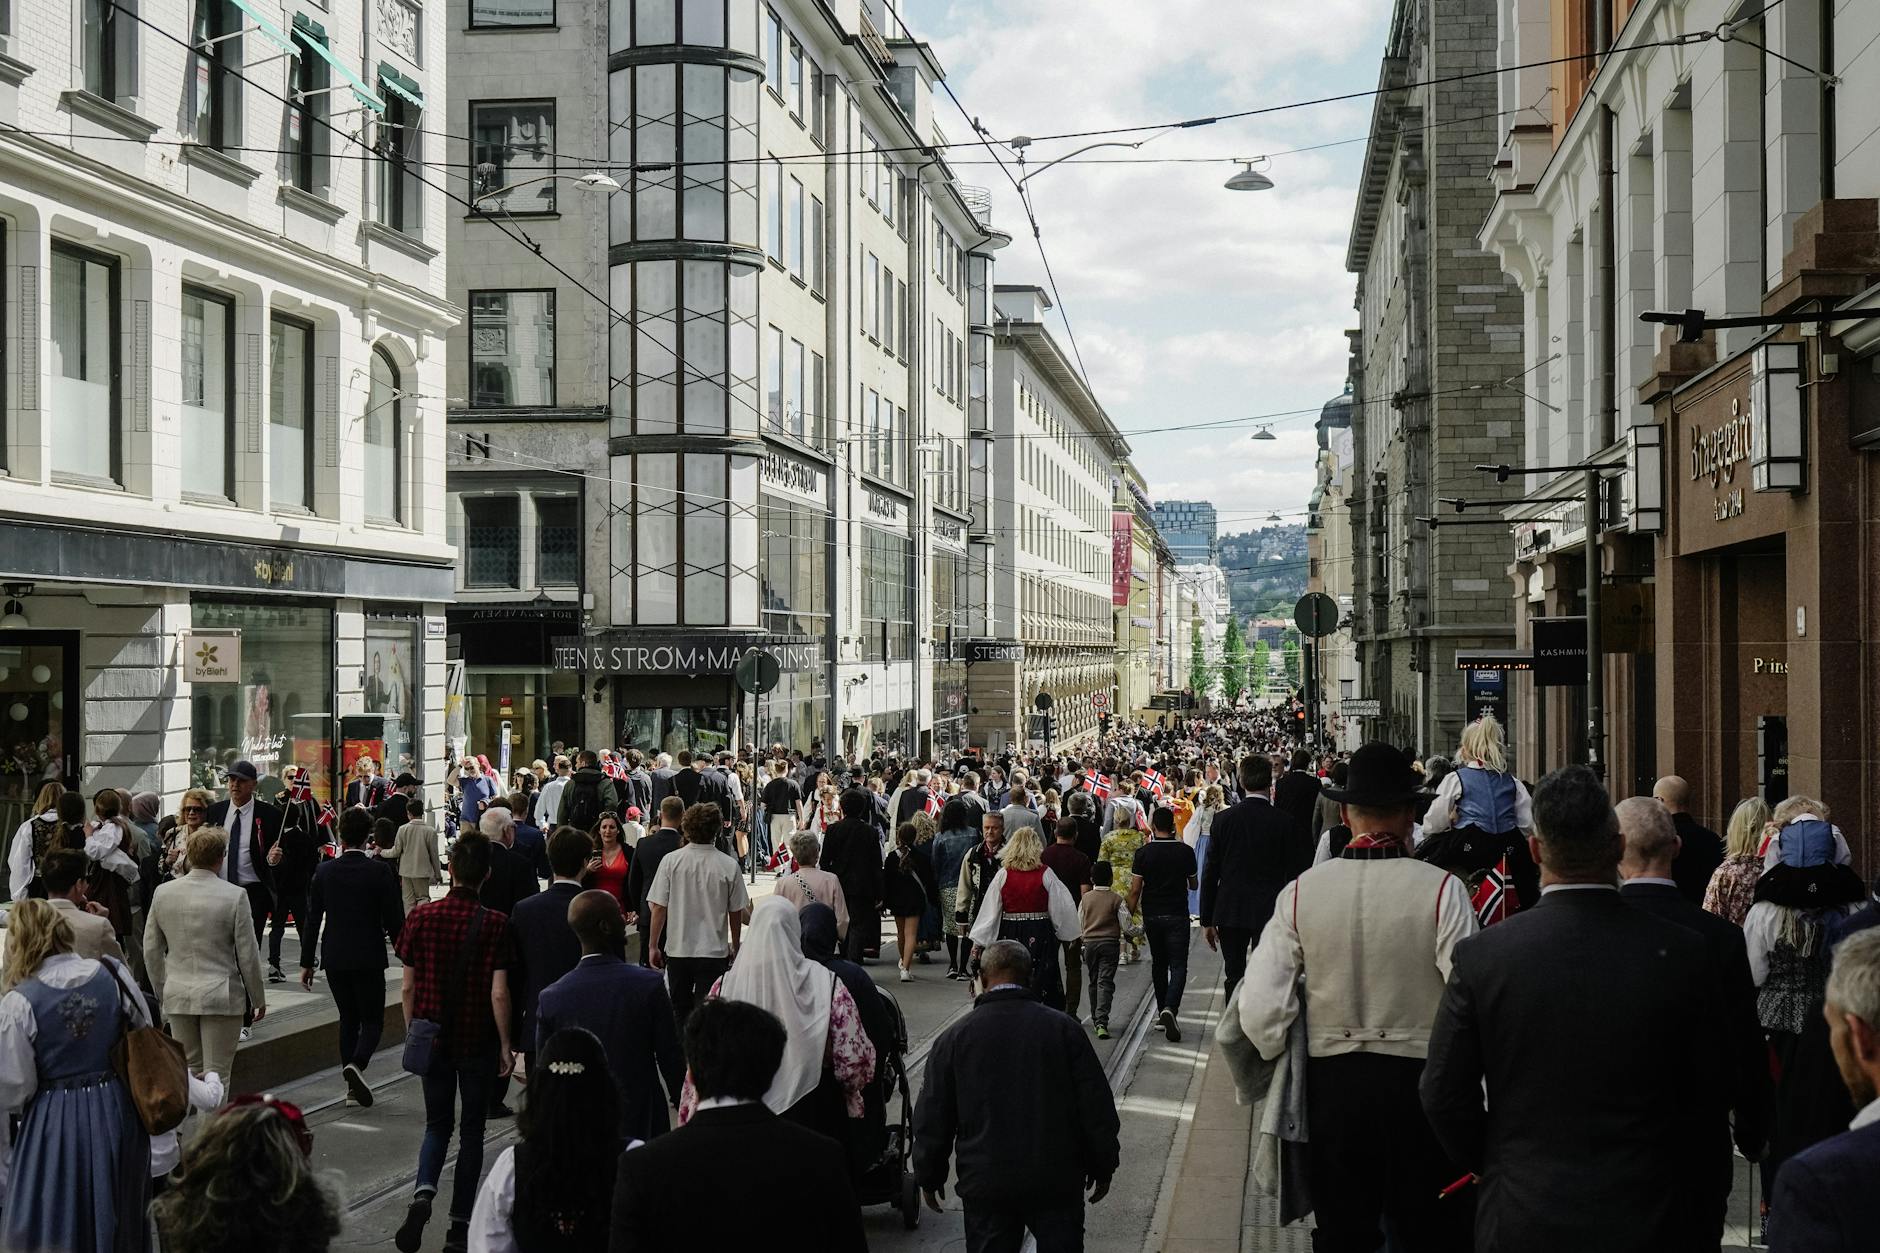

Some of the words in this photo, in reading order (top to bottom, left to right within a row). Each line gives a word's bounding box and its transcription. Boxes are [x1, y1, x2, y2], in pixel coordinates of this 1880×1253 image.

[554, 647, 588, 670] STEEN
[592, 647, 605, 670] &
[610, 646, 696, 671] STRØM
[707, 646, 799, 670] MASIN
[974, 646, 1009, 660] STEEN
[195, 666, 228, 677] byBiehl
